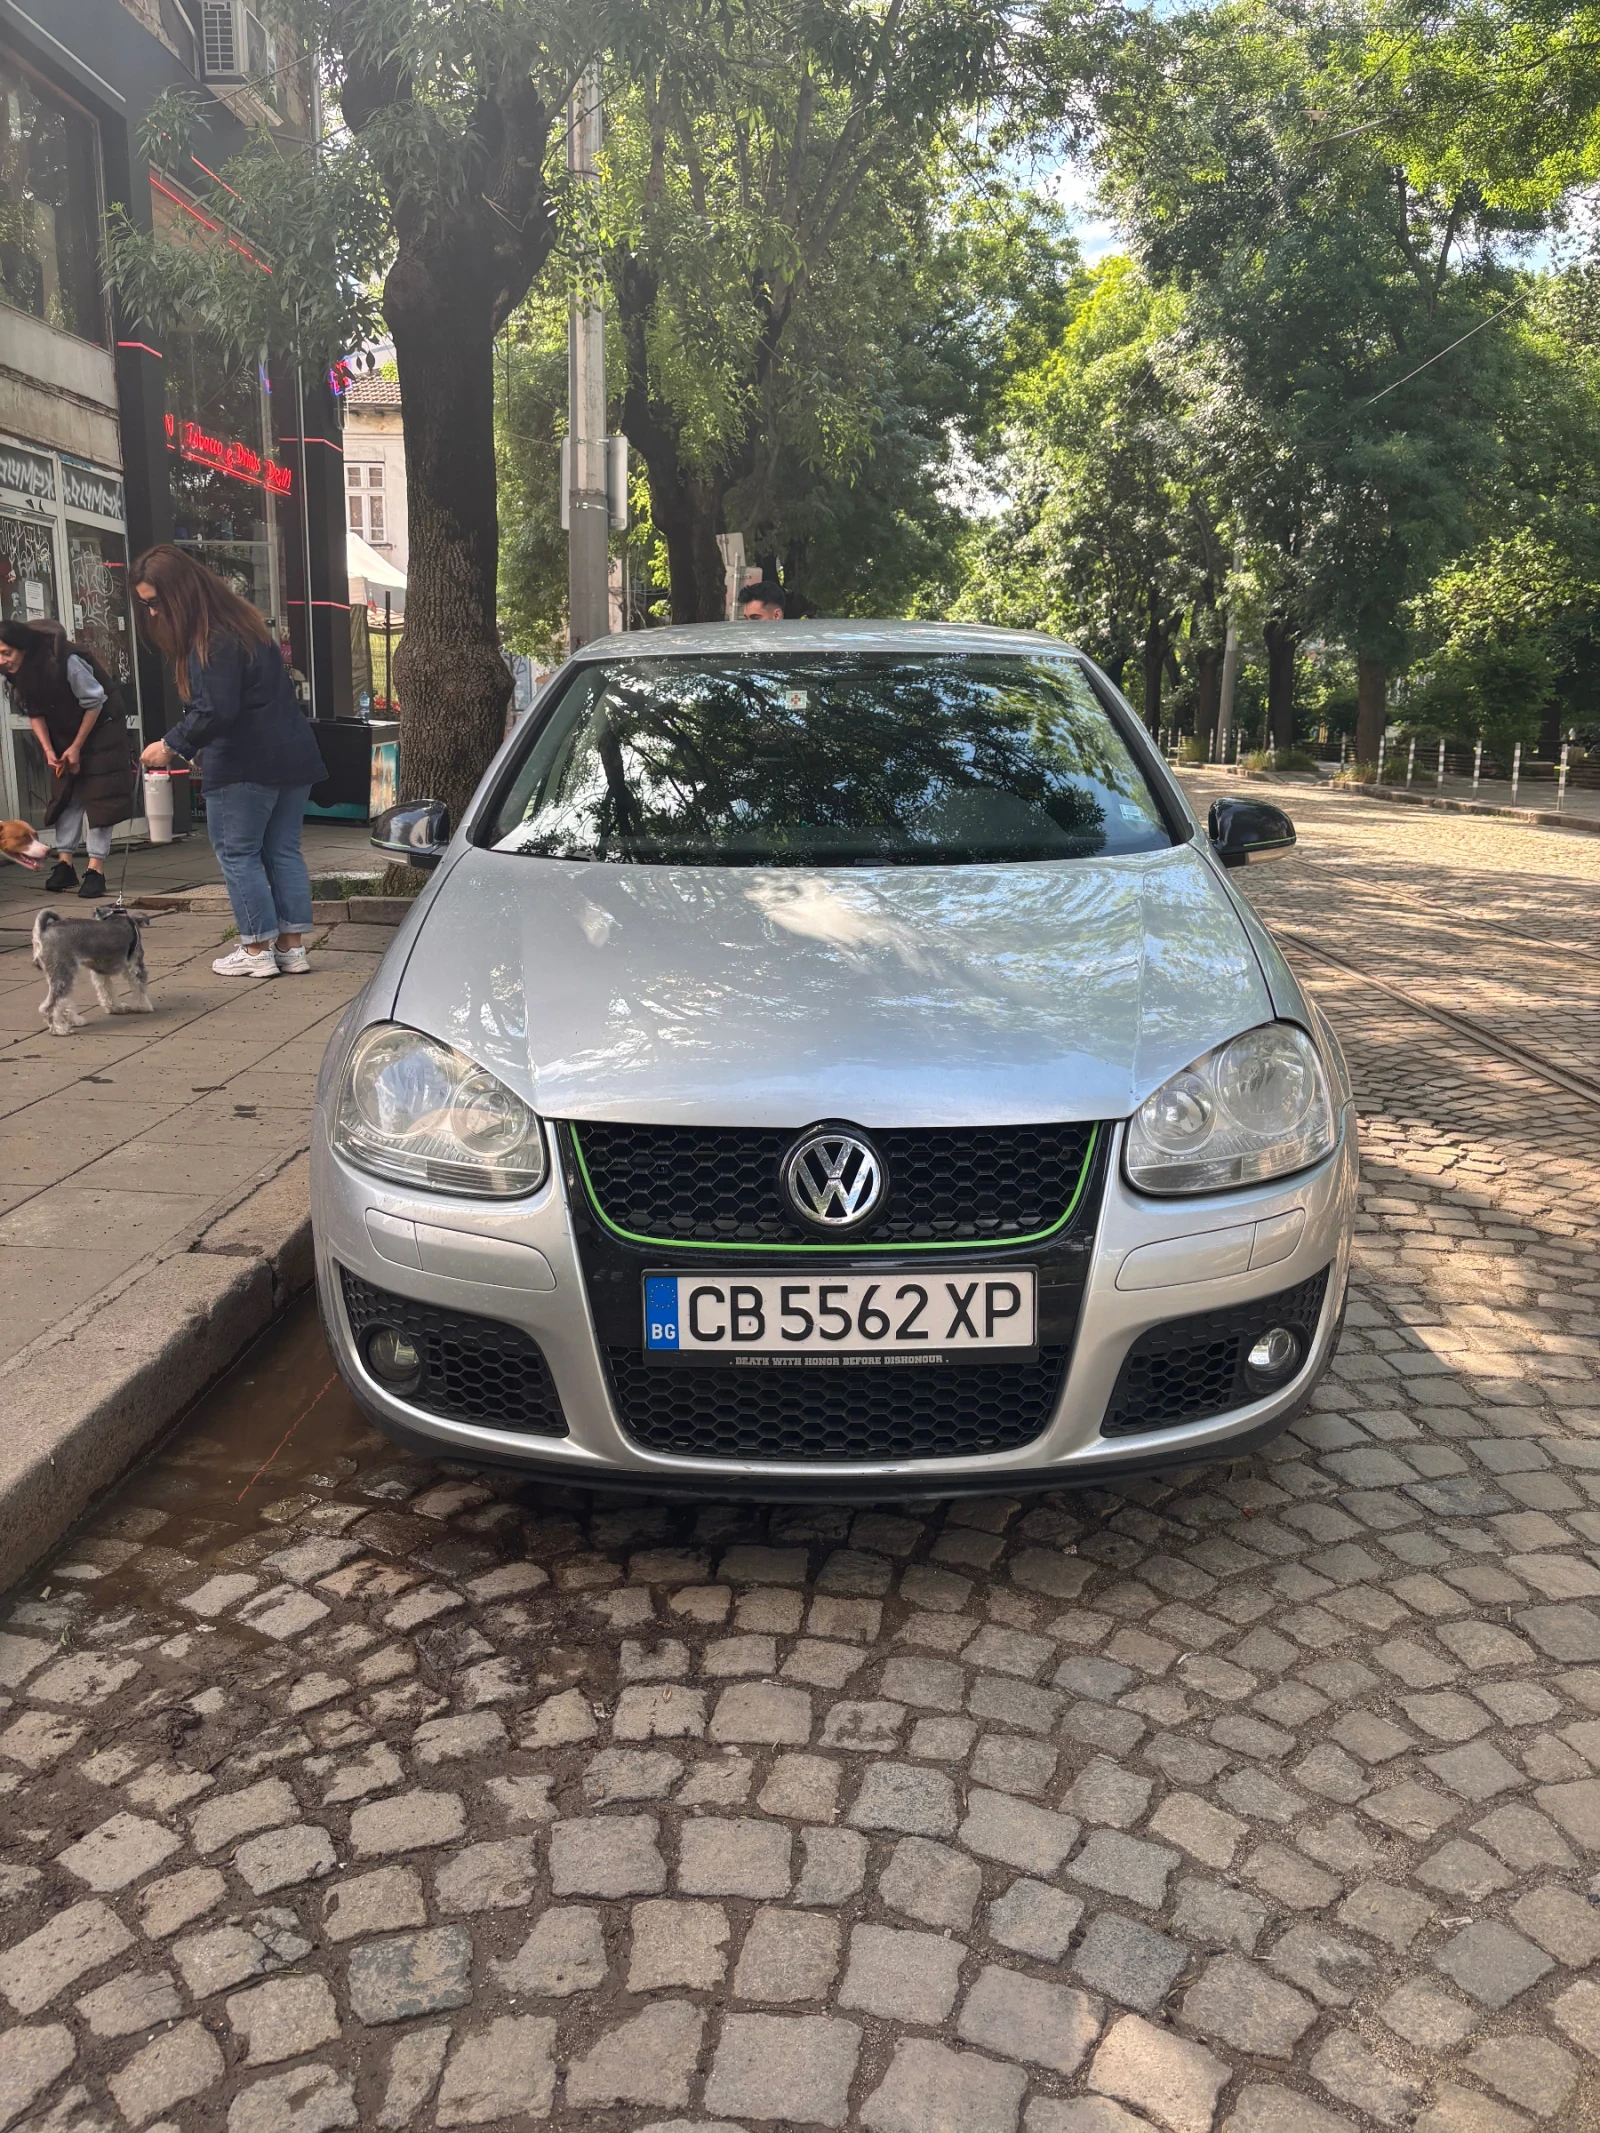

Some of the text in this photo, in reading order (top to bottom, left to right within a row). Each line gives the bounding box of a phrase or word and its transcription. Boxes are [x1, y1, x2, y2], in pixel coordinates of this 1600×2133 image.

[235, 442, 261, 473] Drinks
[651, 1323, 676, 1341] BG
[735, 1354, 943, 1366] DEATH WITH HONOR BEFORE DISHONOUR
